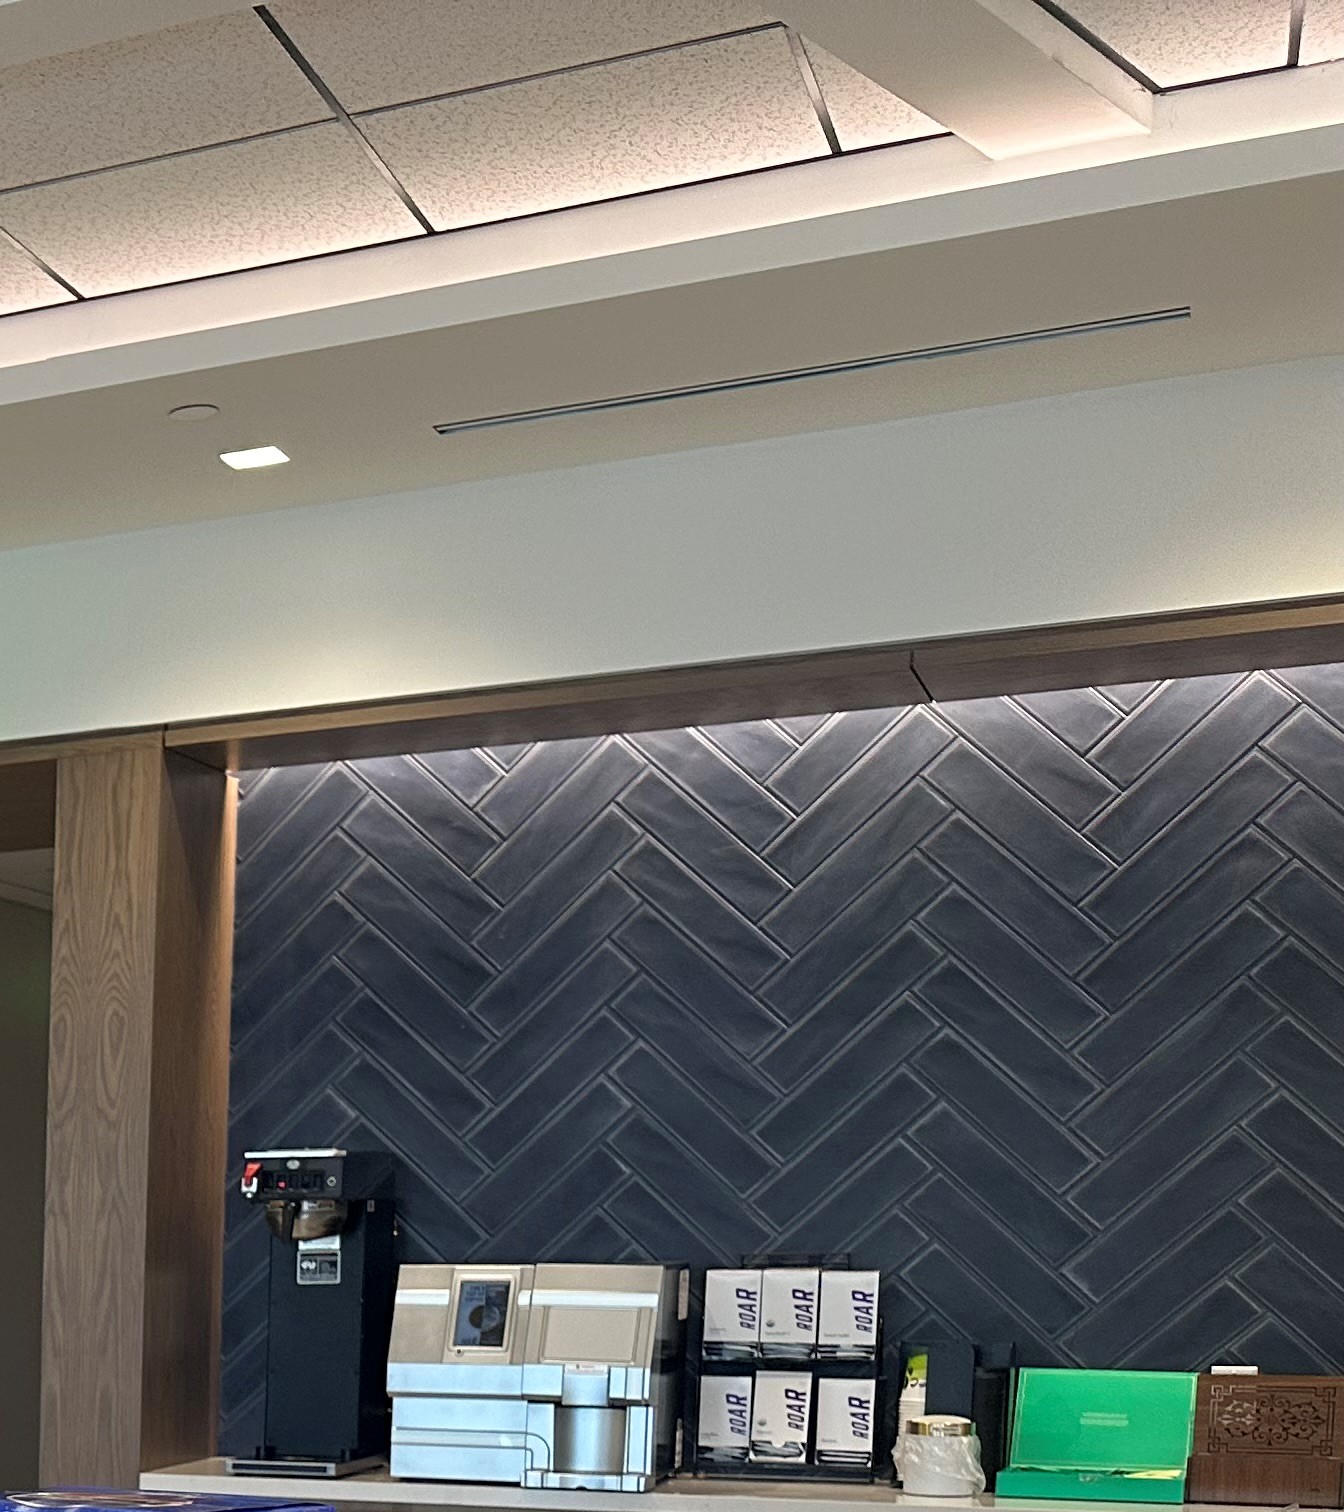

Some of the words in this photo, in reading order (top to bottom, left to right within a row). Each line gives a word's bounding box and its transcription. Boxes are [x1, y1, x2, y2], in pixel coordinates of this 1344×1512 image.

[735, 1287, 758, 1331] ROAR
[792, 1288, 814, 1331] ROAR
[851, 1290, 874, 1333] ROAR
[725, 1393, 748, 1436] ROAR
[785, 1388, 807, 1431] ROAR
[848, 1396, 870, 1439] ROAR
